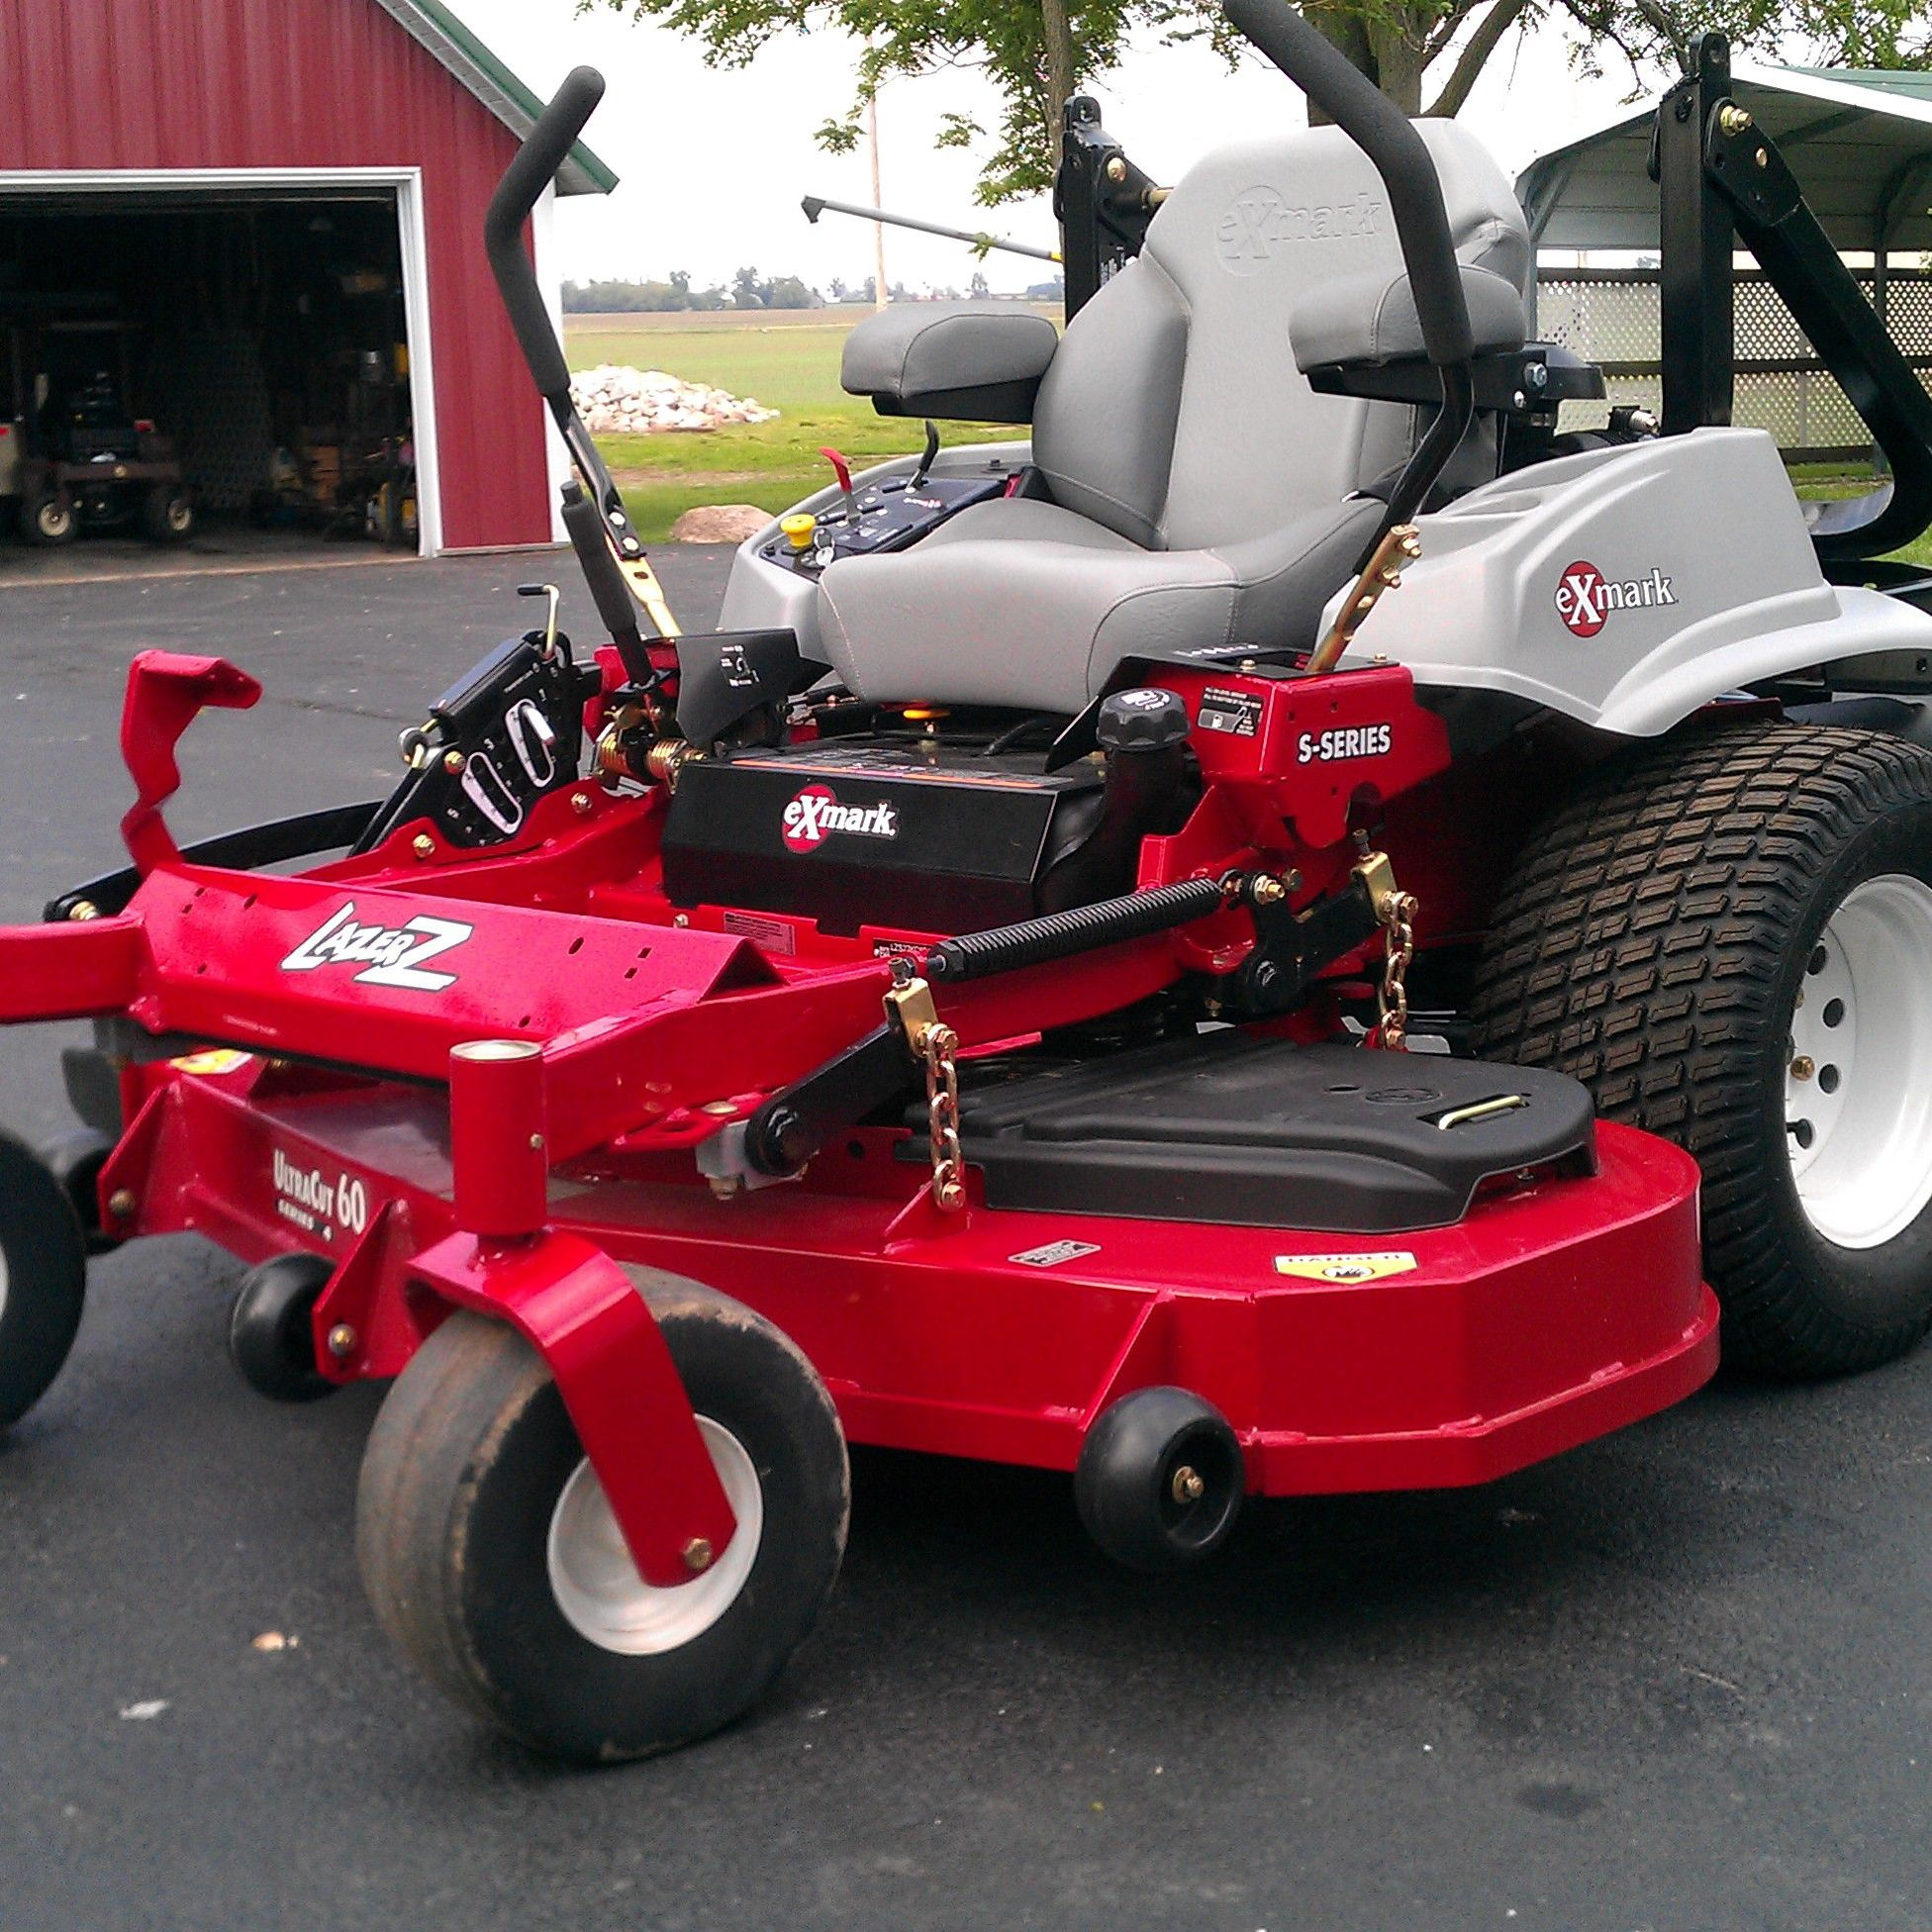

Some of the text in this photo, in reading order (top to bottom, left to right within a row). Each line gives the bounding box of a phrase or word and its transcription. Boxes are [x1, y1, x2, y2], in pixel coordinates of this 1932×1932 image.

[1555, 567, 1677, 626] eXmark
[1298, 724, 1392, 763] S-SERIES
[338, 1173, 366, 1235] 60
